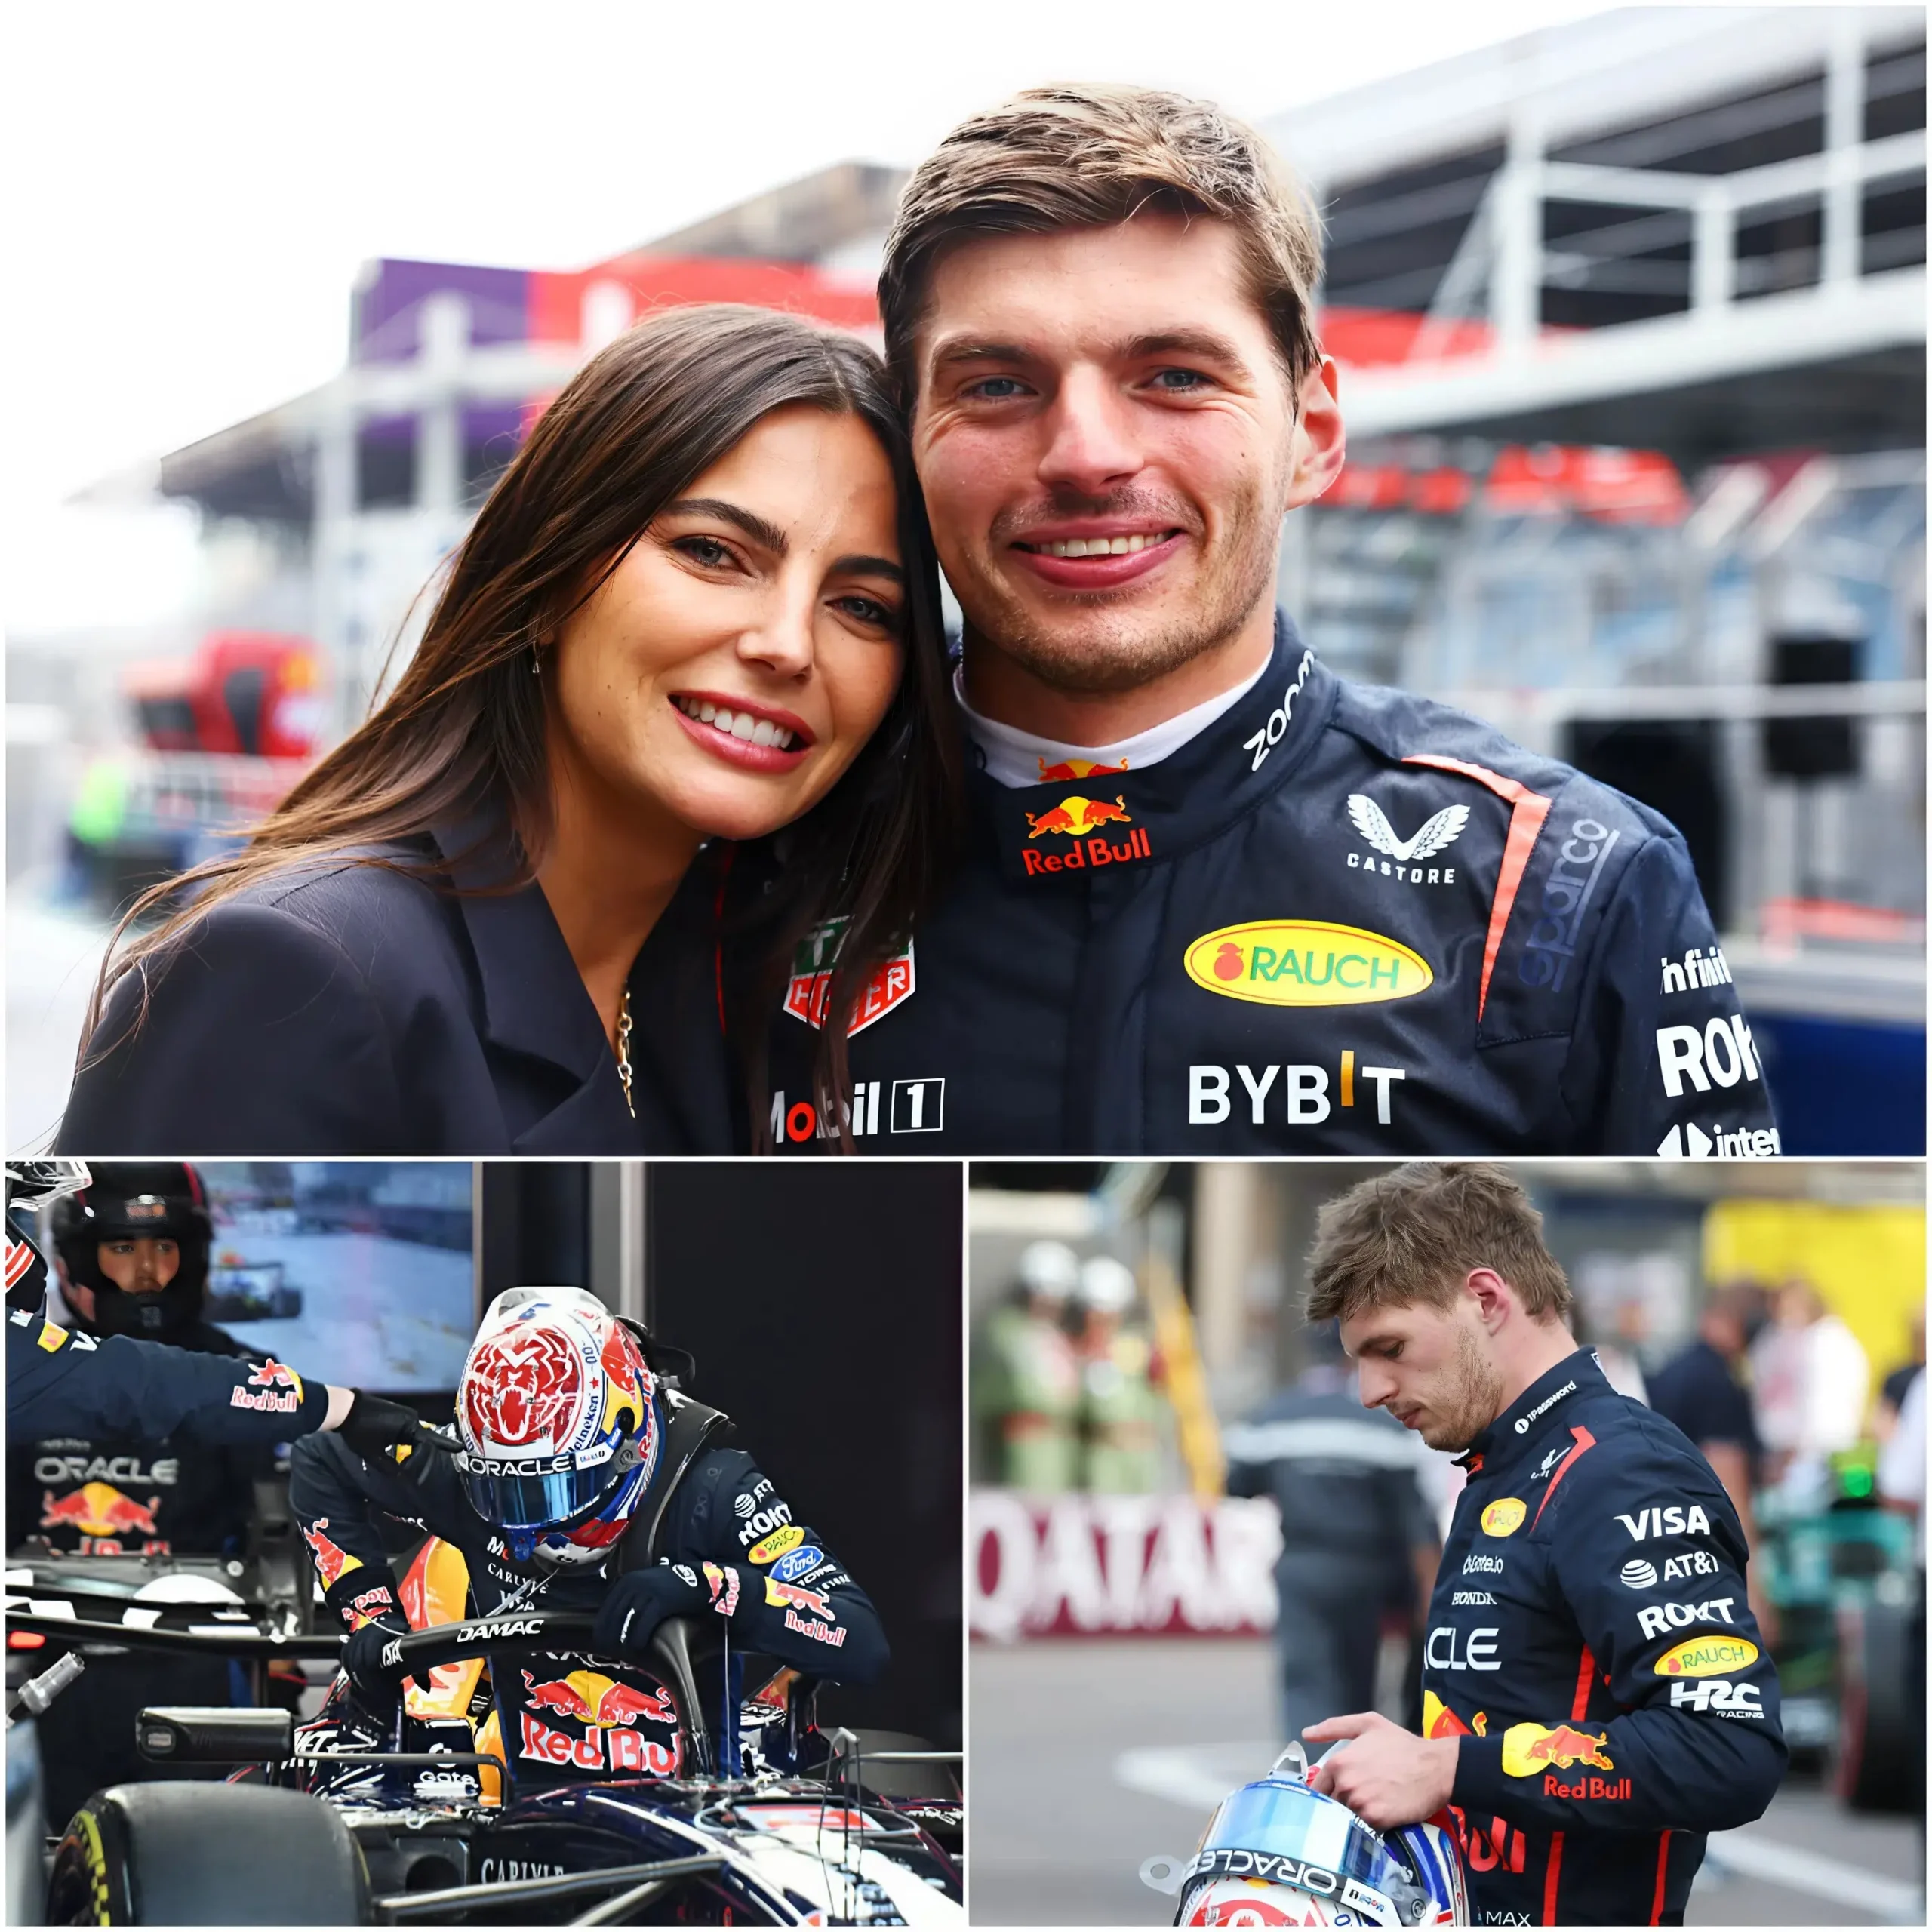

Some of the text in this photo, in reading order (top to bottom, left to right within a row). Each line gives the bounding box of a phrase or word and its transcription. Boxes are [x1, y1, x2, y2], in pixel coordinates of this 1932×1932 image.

[1022, 829, 1151, 875] Red Bull
[1347, 853, 1455, 884] CASTORE
[1249, 946, 1400, 990] RAUCH
[1189, 1050, 1406, 1124] BYBIT
[230, 1386, 267, 1411] Red
[1527, 1380, 1577, 1422] 1Password
[35, 1457, 180, 1484] ORACLE
[469, 1456, 571, 1476] ORACLE
[1614, 1506, 1710, 1542] VISA
[969, 1493, 1283, 1642] QATAR
[1451, 1592, 1497, 1605] HONDA
[457, 1620, 544, 1643] DAMAC
[1637, 1598, 1734, 1640] ROKT
[1424, 1627, 1502, 1671] CLE
[1682, 1646, 1745, 1669] RAUCH
[1670, 1680, 1763, 1712] HRC
[1716, 1711, 1765, 1720] RACING
[519, 1710, 605, 1770] Red
[1544, 1774, 1632, 1799] Red Bull
[1486, 1911, 1531, 1927] MAX
